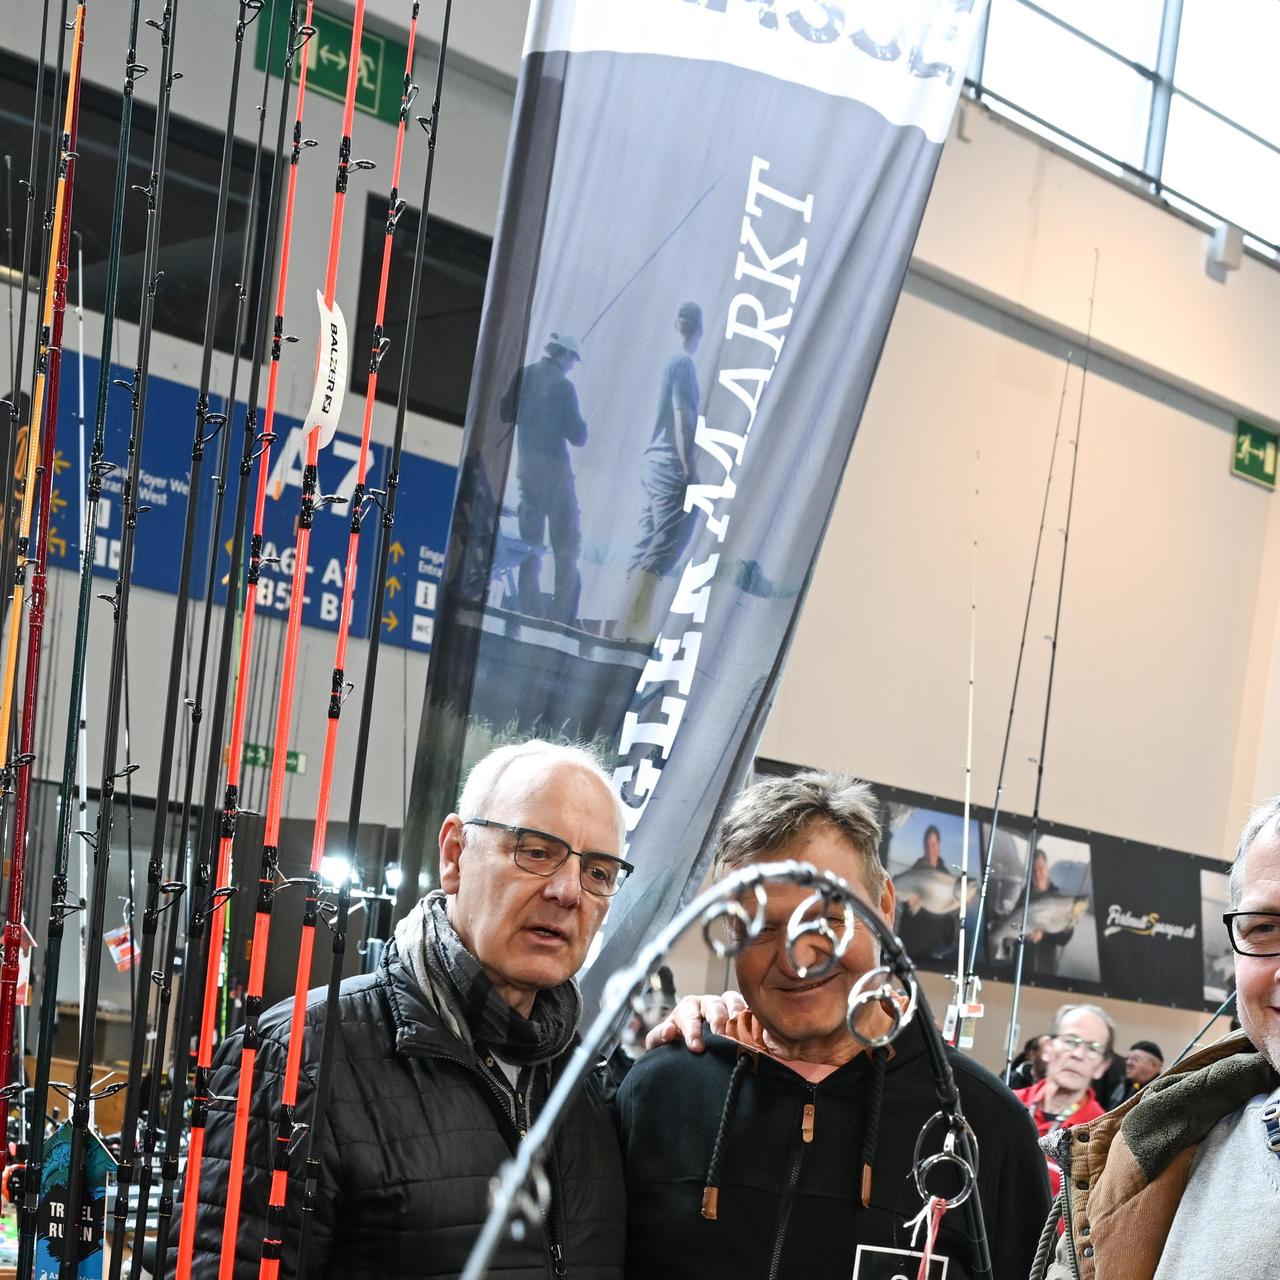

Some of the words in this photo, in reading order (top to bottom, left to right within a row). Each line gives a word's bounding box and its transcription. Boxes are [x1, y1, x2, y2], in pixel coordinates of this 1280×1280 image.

[324, 322, 338, 394] BALZER
[265, 426, 375, 518] A7
[48, 1222, 93, 1242] RUN
[49, 1201, 94, 1222] TREL
